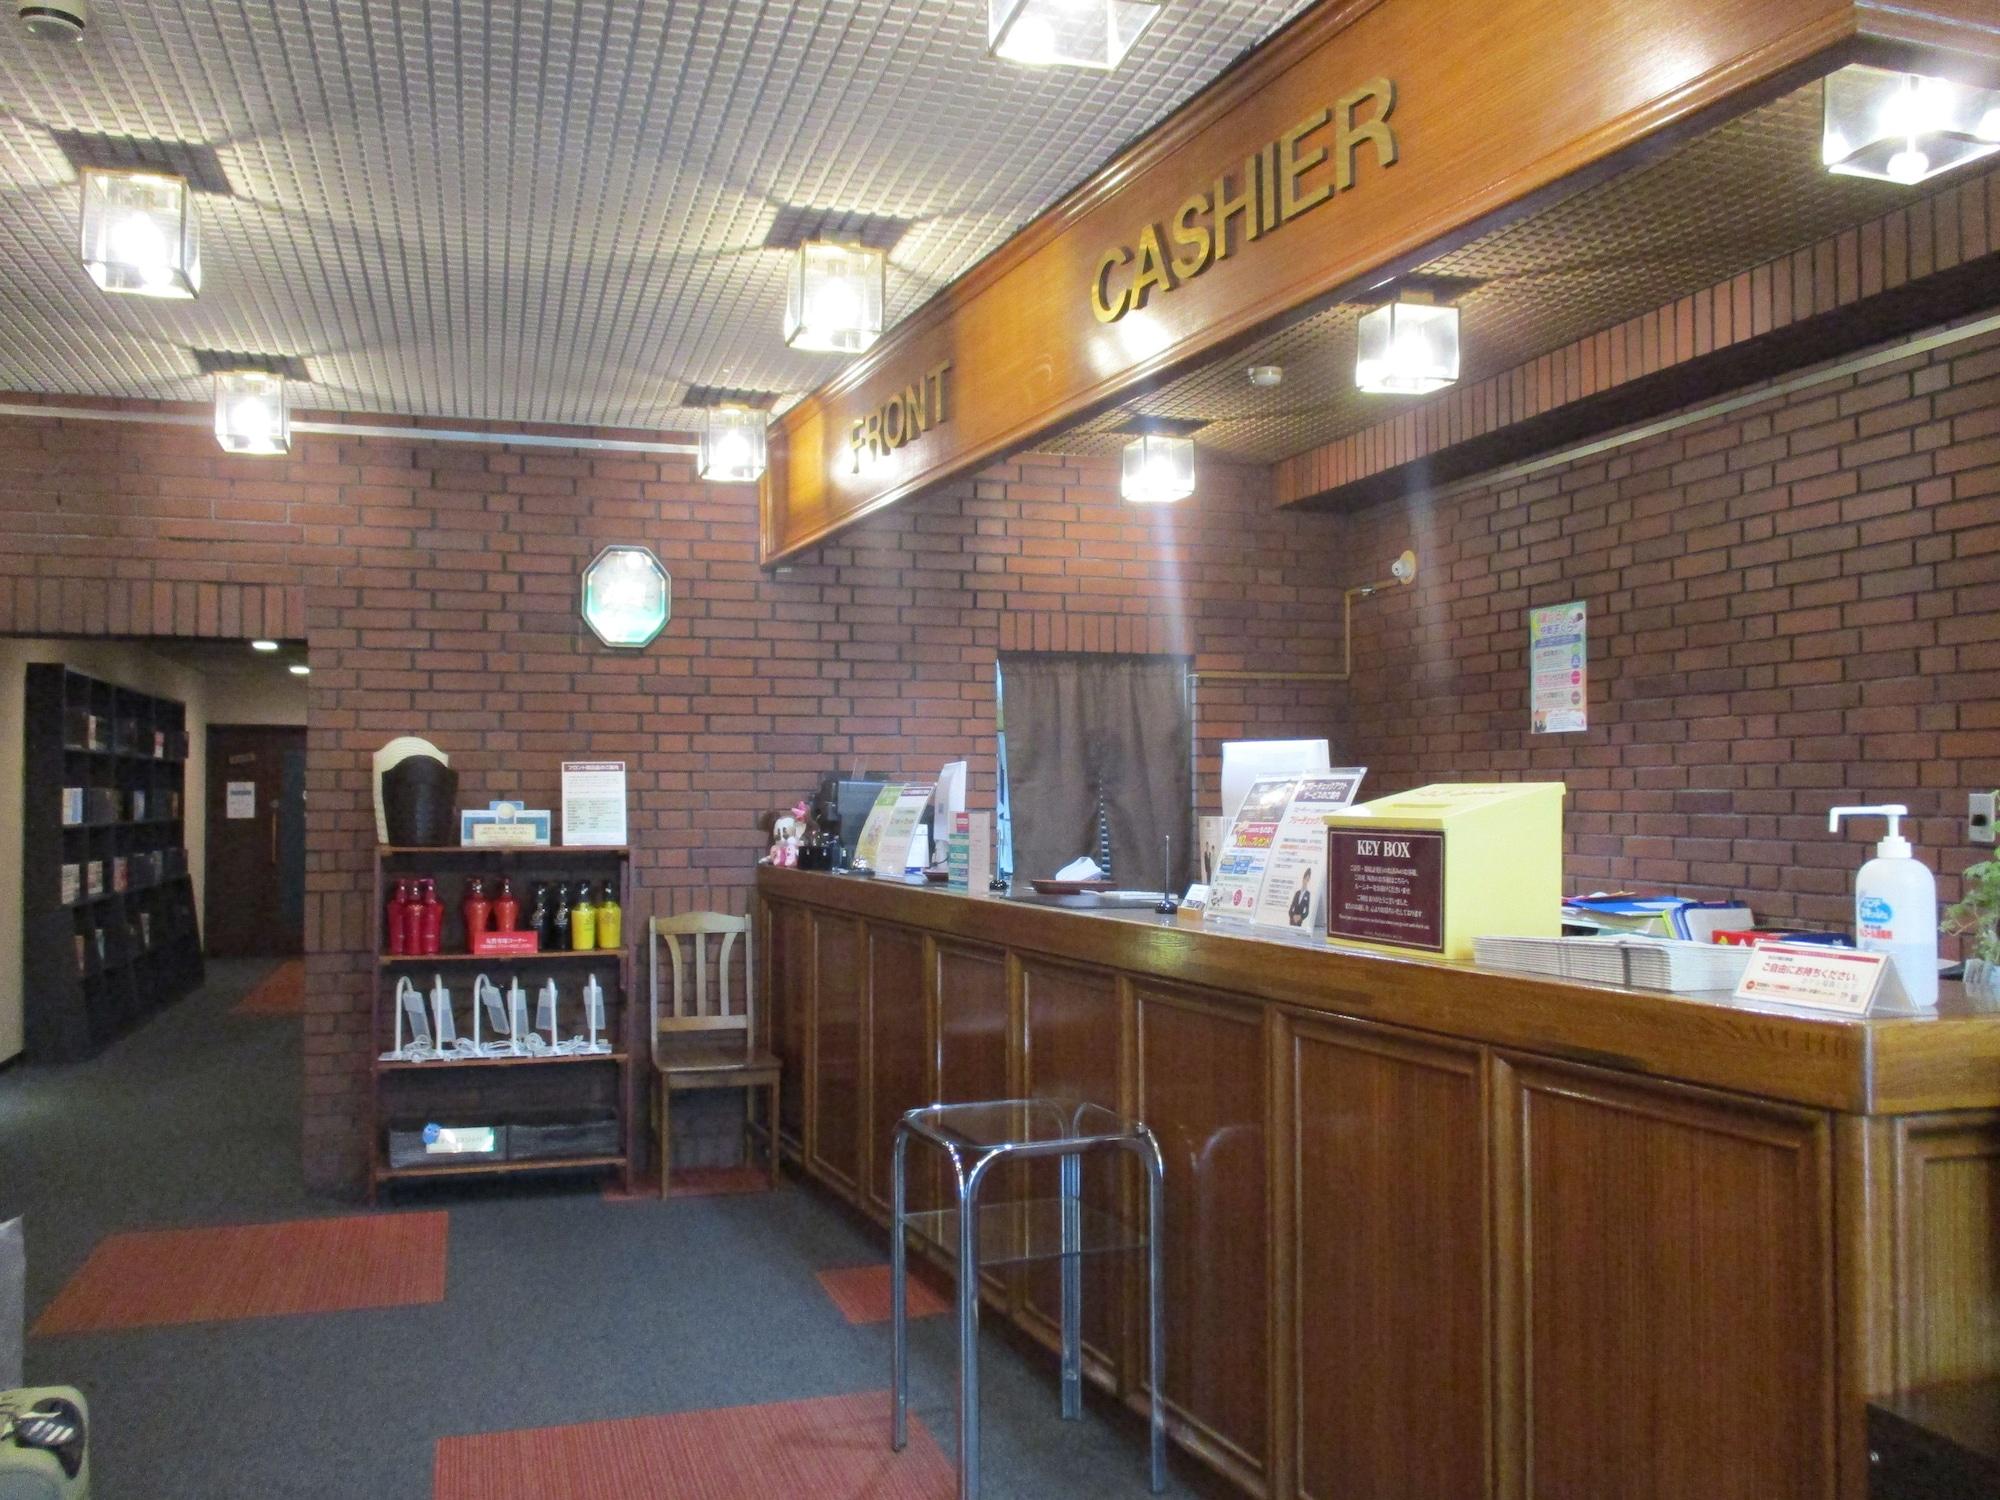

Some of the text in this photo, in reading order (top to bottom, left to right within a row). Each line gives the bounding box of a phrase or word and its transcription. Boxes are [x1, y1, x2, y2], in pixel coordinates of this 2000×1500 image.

[1090, 76, 1398, 323] CASHIER
[849, 359, 951, 473] FRONT
[1357, 840, 1411, 858] KEY BOX
